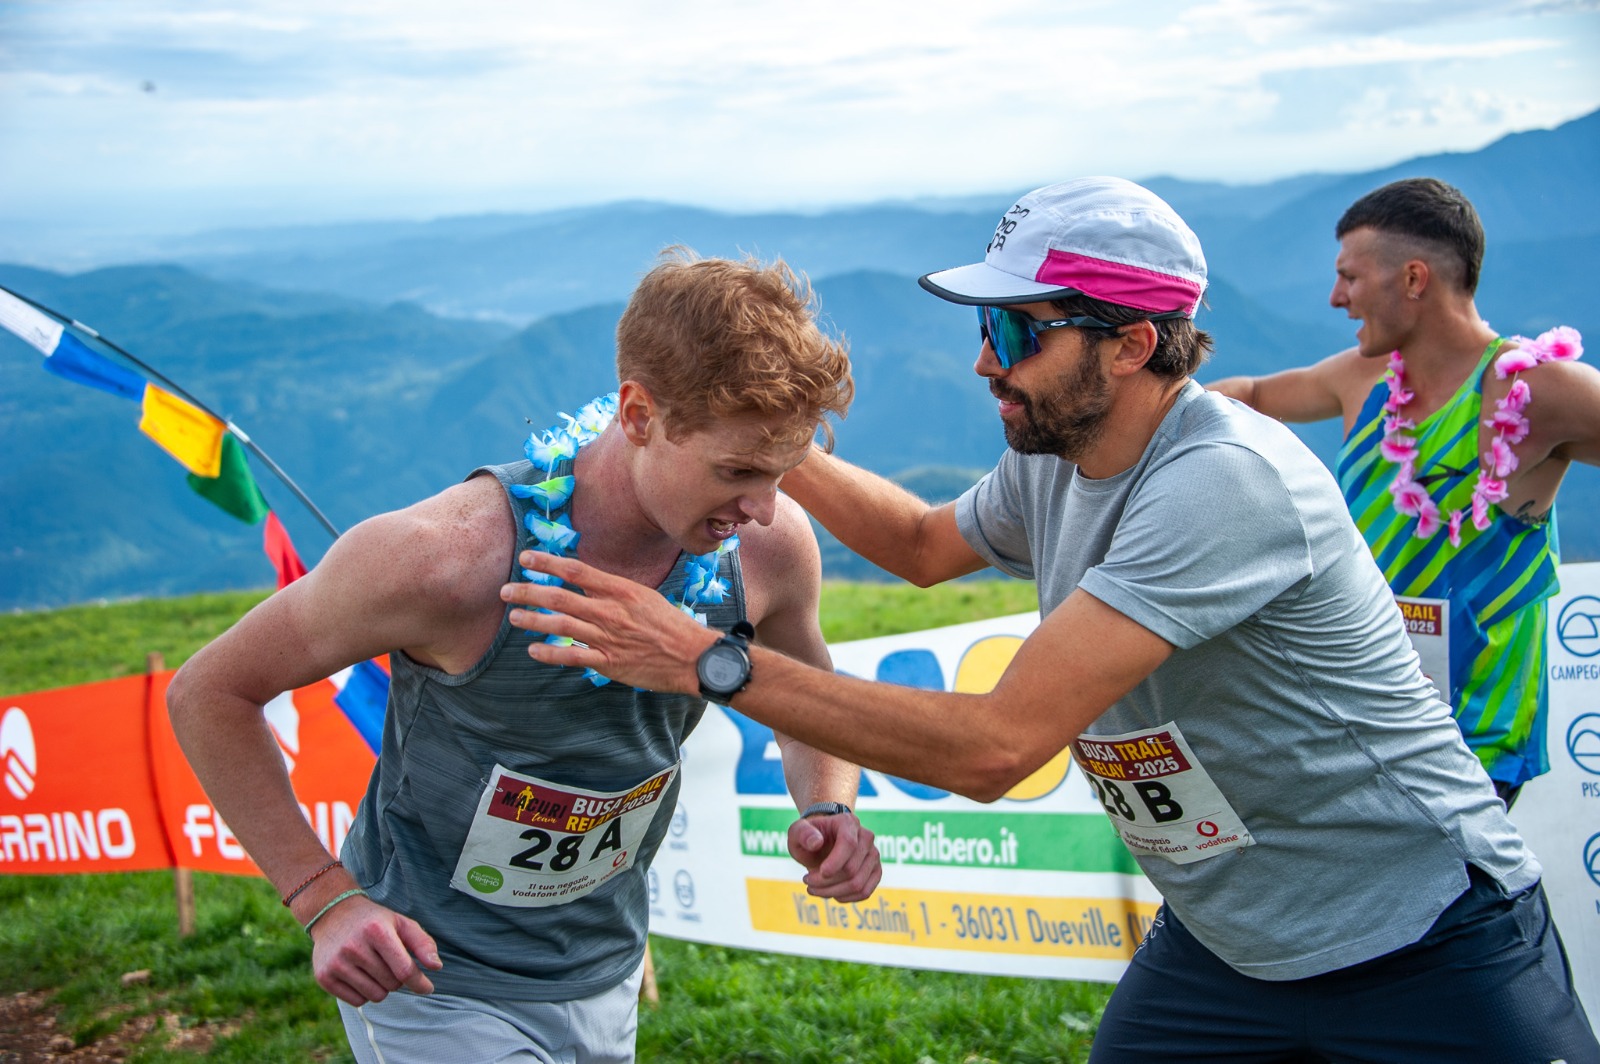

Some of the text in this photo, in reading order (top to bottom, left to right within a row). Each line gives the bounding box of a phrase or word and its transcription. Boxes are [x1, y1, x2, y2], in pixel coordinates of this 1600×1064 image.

[1551, 664, 1600, 680] CAMPEG
[1079, 741, 1120, 762] BUSA
[1115, 738, 1172, 762] TRAIL
[1089, 759, 1126, 778] RELAY
[1134, 756, 1180, 777] 2025
[502, 791, 567, 818] MACURI
[571, 776, 664, 817] BUSA TRAIL
[1086, 772, 1184, 823] 28 B
[565, 810, 614, 832] RELAY
[619, 790, 656, 814] 2025
[0, 808, 136, 862] RRINO
[182, 801, 354, 861] FEIN
[509, 815, 622, 872] 28 A
[1195, 834, 1239, 851] vodafone
[1158, 844, 1189, 853] fiducia
[512, 878, 597, 898] Vodafone di fiducia
[538, 883, 555, 891] tuo
[557, 875, 590, 890] negozio
[792, 892, 820, 926] Via
[919, 902, 932, 936] 1
[952, 903, 1020, 942] 36031
[1026, 907, 1122, 947] Dueville
